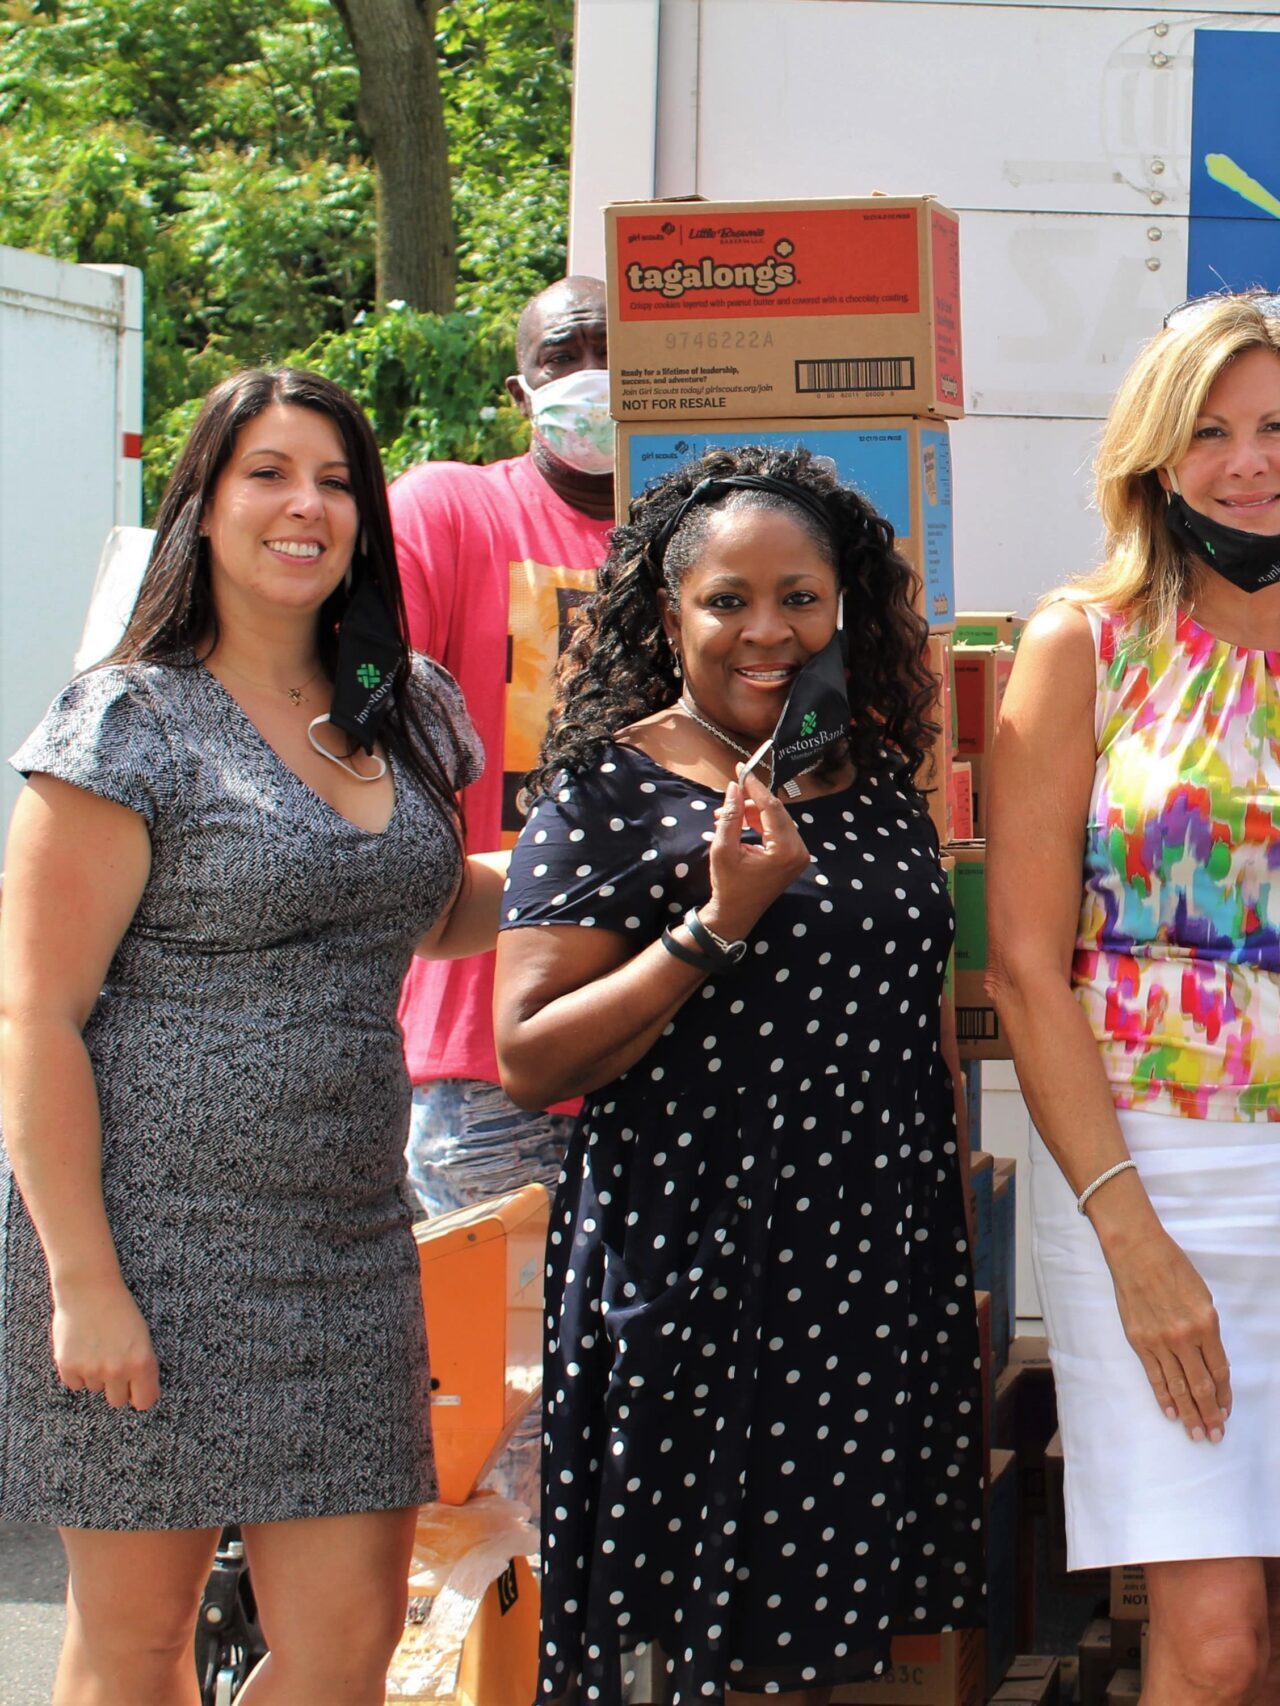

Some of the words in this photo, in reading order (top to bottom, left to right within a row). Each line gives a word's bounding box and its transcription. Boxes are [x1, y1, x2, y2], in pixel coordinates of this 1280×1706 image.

[626, 256, 796, 298] tagalongs
[666, 331, 774, 349] 9746222A
[700, 366, 739, 375] leadership,
[668, 376, 707, 384] adventure?
[680, 387, 704, 395] today!
[706, 384, 773, 395] girlscouts.org/join
[622, 400, 648, 410] NOT
[652, 399, 676, 409] FOR
[680, 398, 726, 408] RESALE
